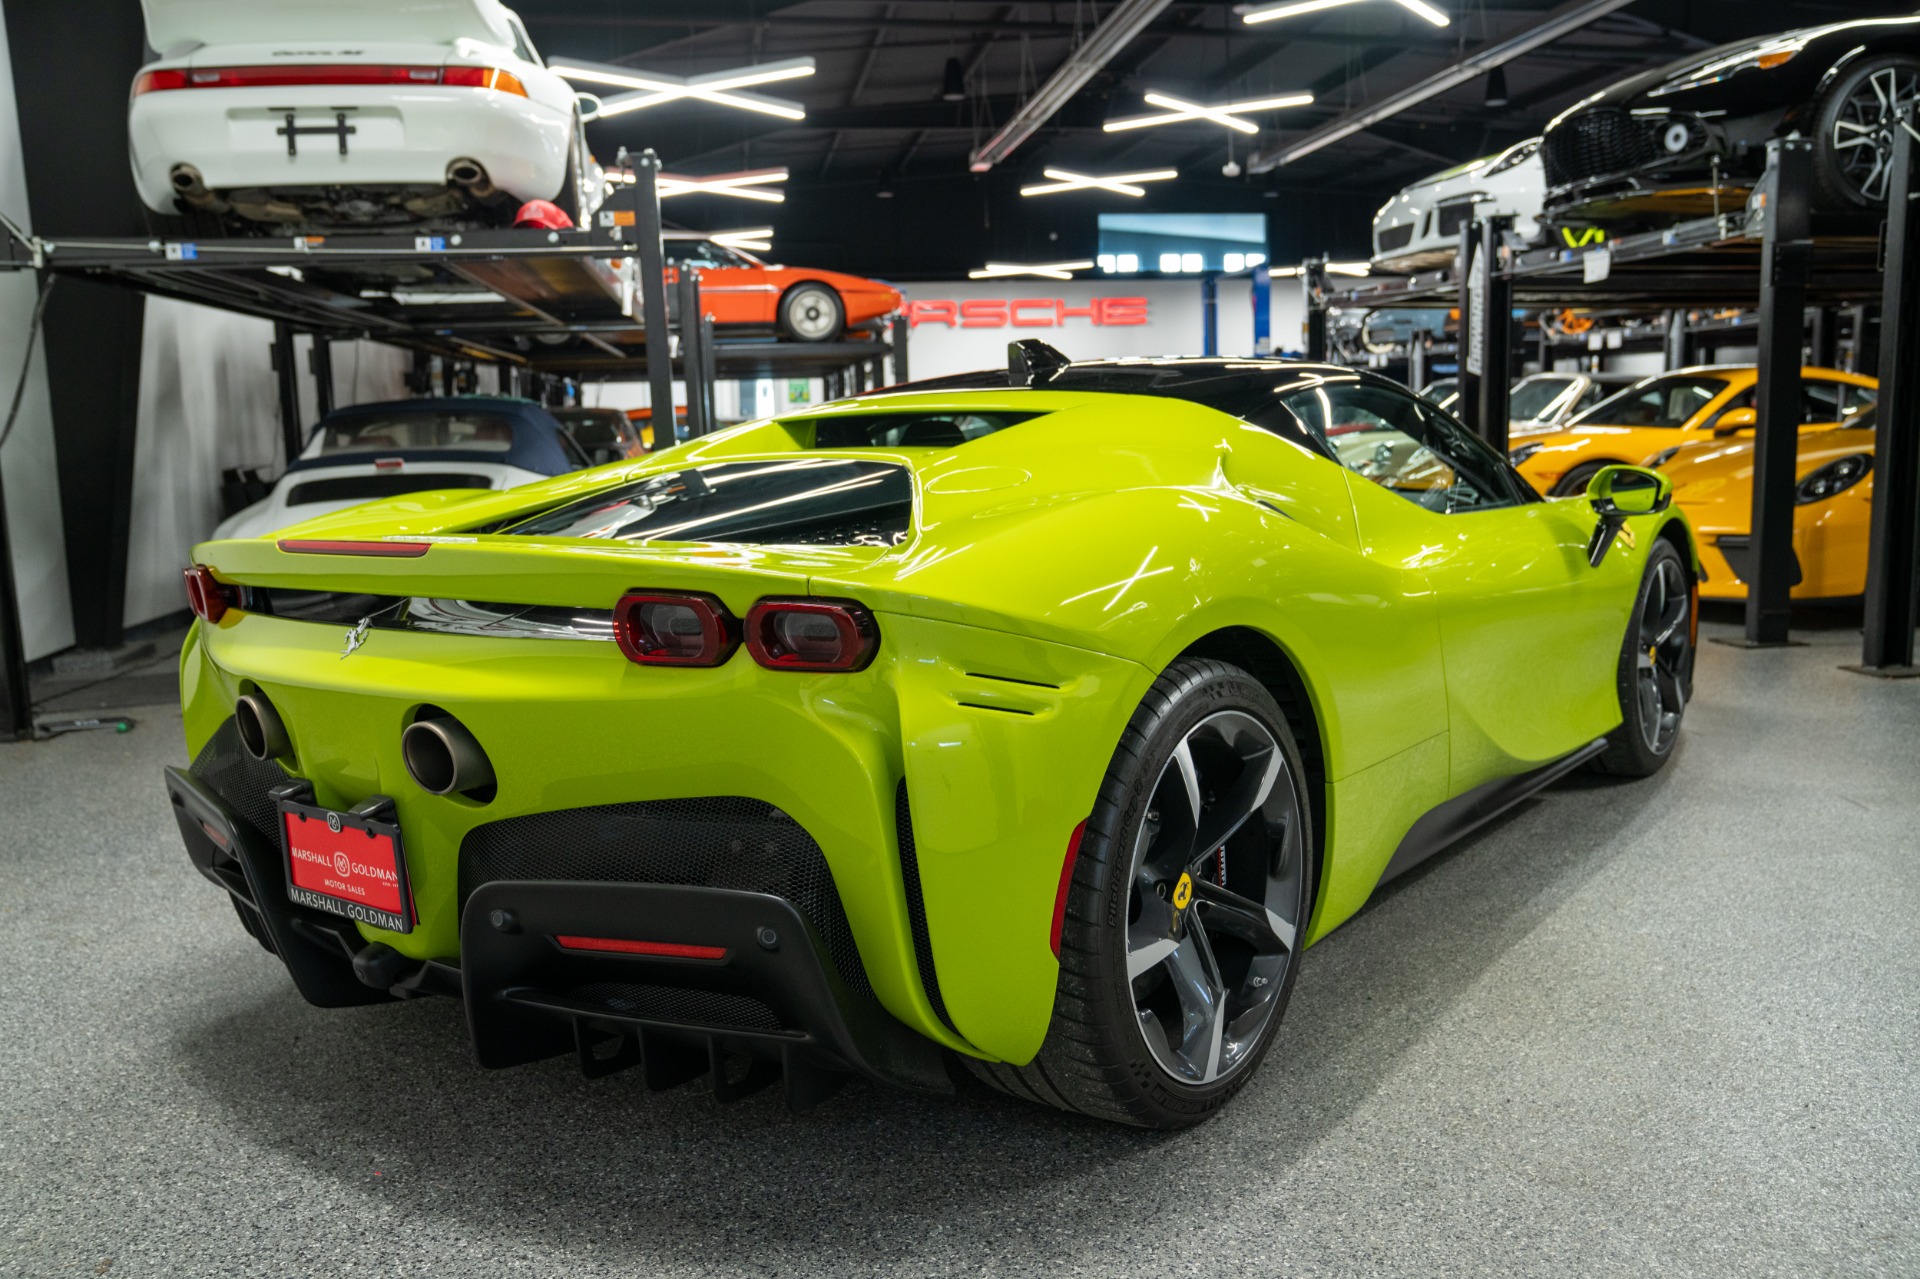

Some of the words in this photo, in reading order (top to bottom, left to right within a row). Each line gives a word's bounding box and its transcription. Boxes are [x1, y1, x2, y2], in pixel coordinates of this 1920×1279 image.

[899, 298, 1148, 327] RSCHE
[1123, 795, 1139, 828] Cup
[291, 847, 332, 867] MARSHALL
[351, 863, 398, 881] GOLDMAN
[1112, 828, 1128, 882] Sport
[324, 879, 346, 891] MOTOR
[347, 885, 365, 896] SALES
[291, 888, 344, 915] MARSHALL
[347, 904, 403, 932] GOLDMAN
[1108, 882, 1118, 928] Pilot
